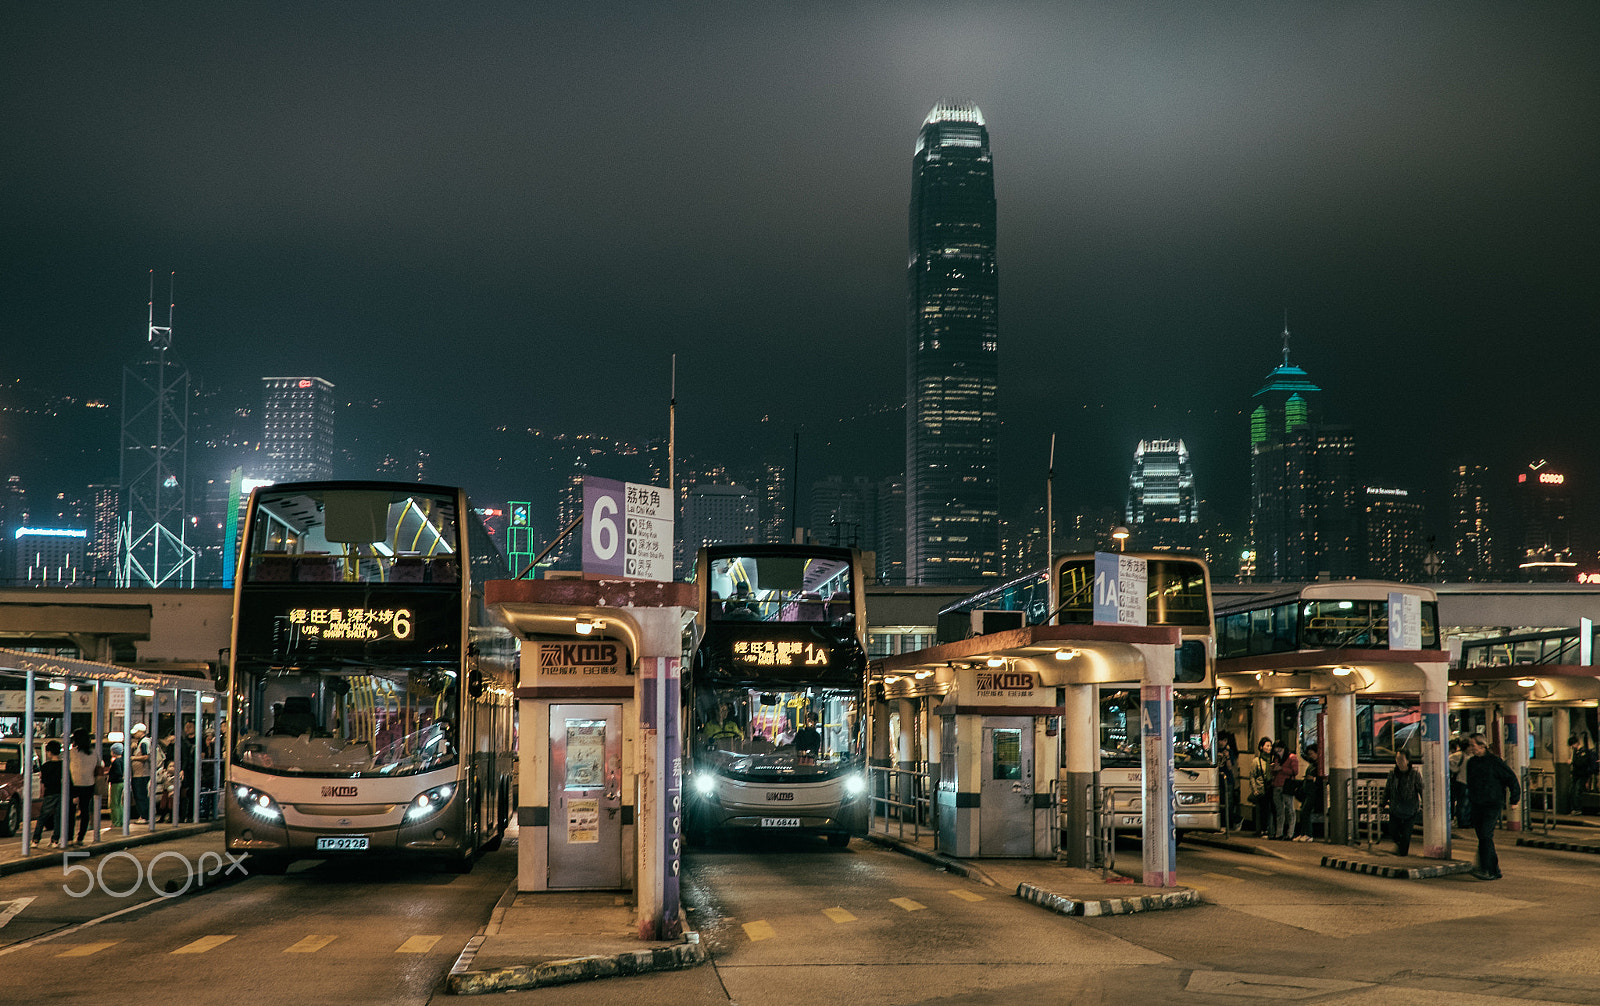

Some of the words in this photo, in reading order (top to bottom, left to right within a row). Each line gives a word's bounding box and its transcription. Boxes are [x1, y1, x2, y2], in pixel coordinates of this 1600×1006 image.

[627, 487, 660, 508] 荔枝角
[627, 504, 635, 514] Lai
[591, 495, 619, 560] 6
[1096, 571, 1118, 607] 1A
[393, 608, 411, 639] 6
[1392, 603, 1402, 638] 5
[563, 644, 618, 666] KMB
[804, 643, 828, 665] 1A
[993, 673, 1034, 690] KMB
[331, 786, 358, 797] KMB
[773, 792, 794, 801] KMB
[320, 839, 335, 848] TP
[338, 839, 366, 848] 9228
